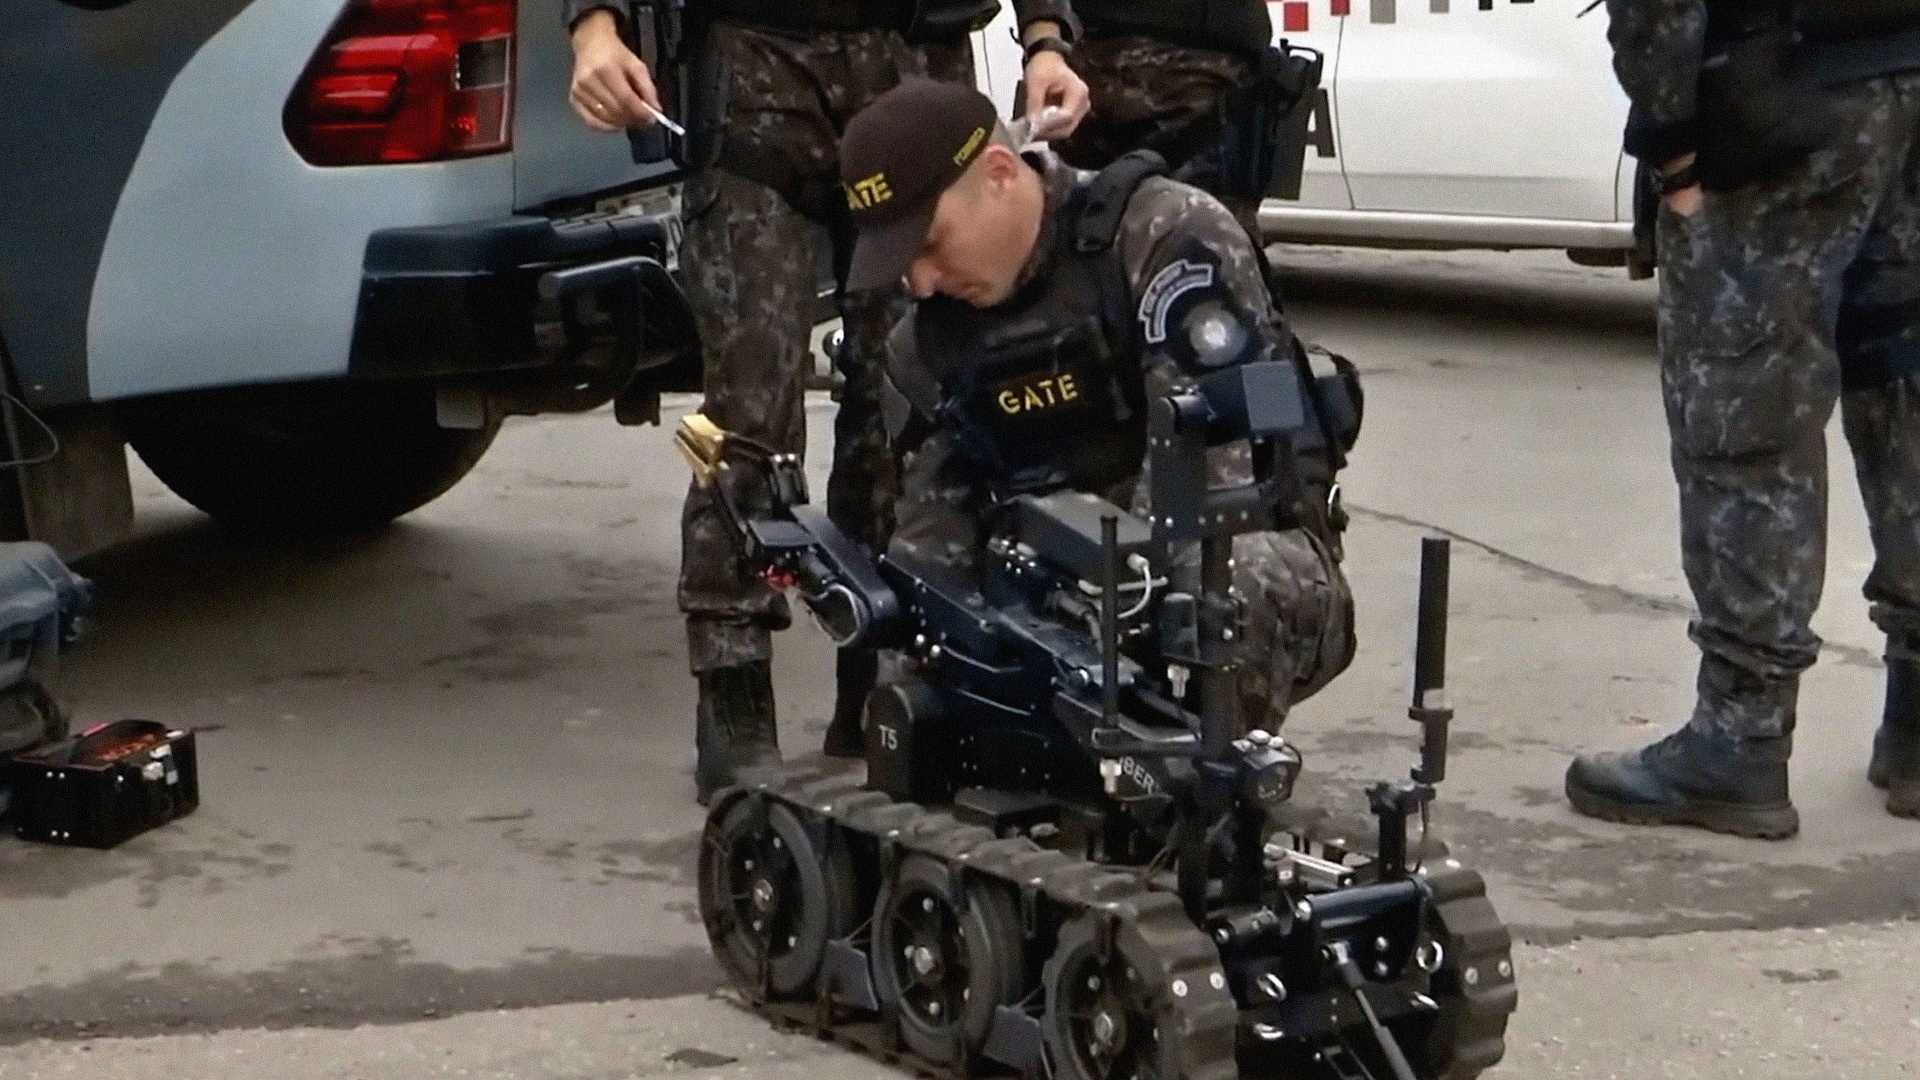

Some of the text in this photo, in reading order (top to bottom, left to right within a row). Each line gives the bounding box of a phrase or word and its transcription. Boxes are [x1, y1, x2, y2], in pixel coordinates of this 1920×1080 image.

[842, 172, 893, 210] ATE
[998, 374, 1078, 414] GATE
[879, 724, 898, 750] T5
